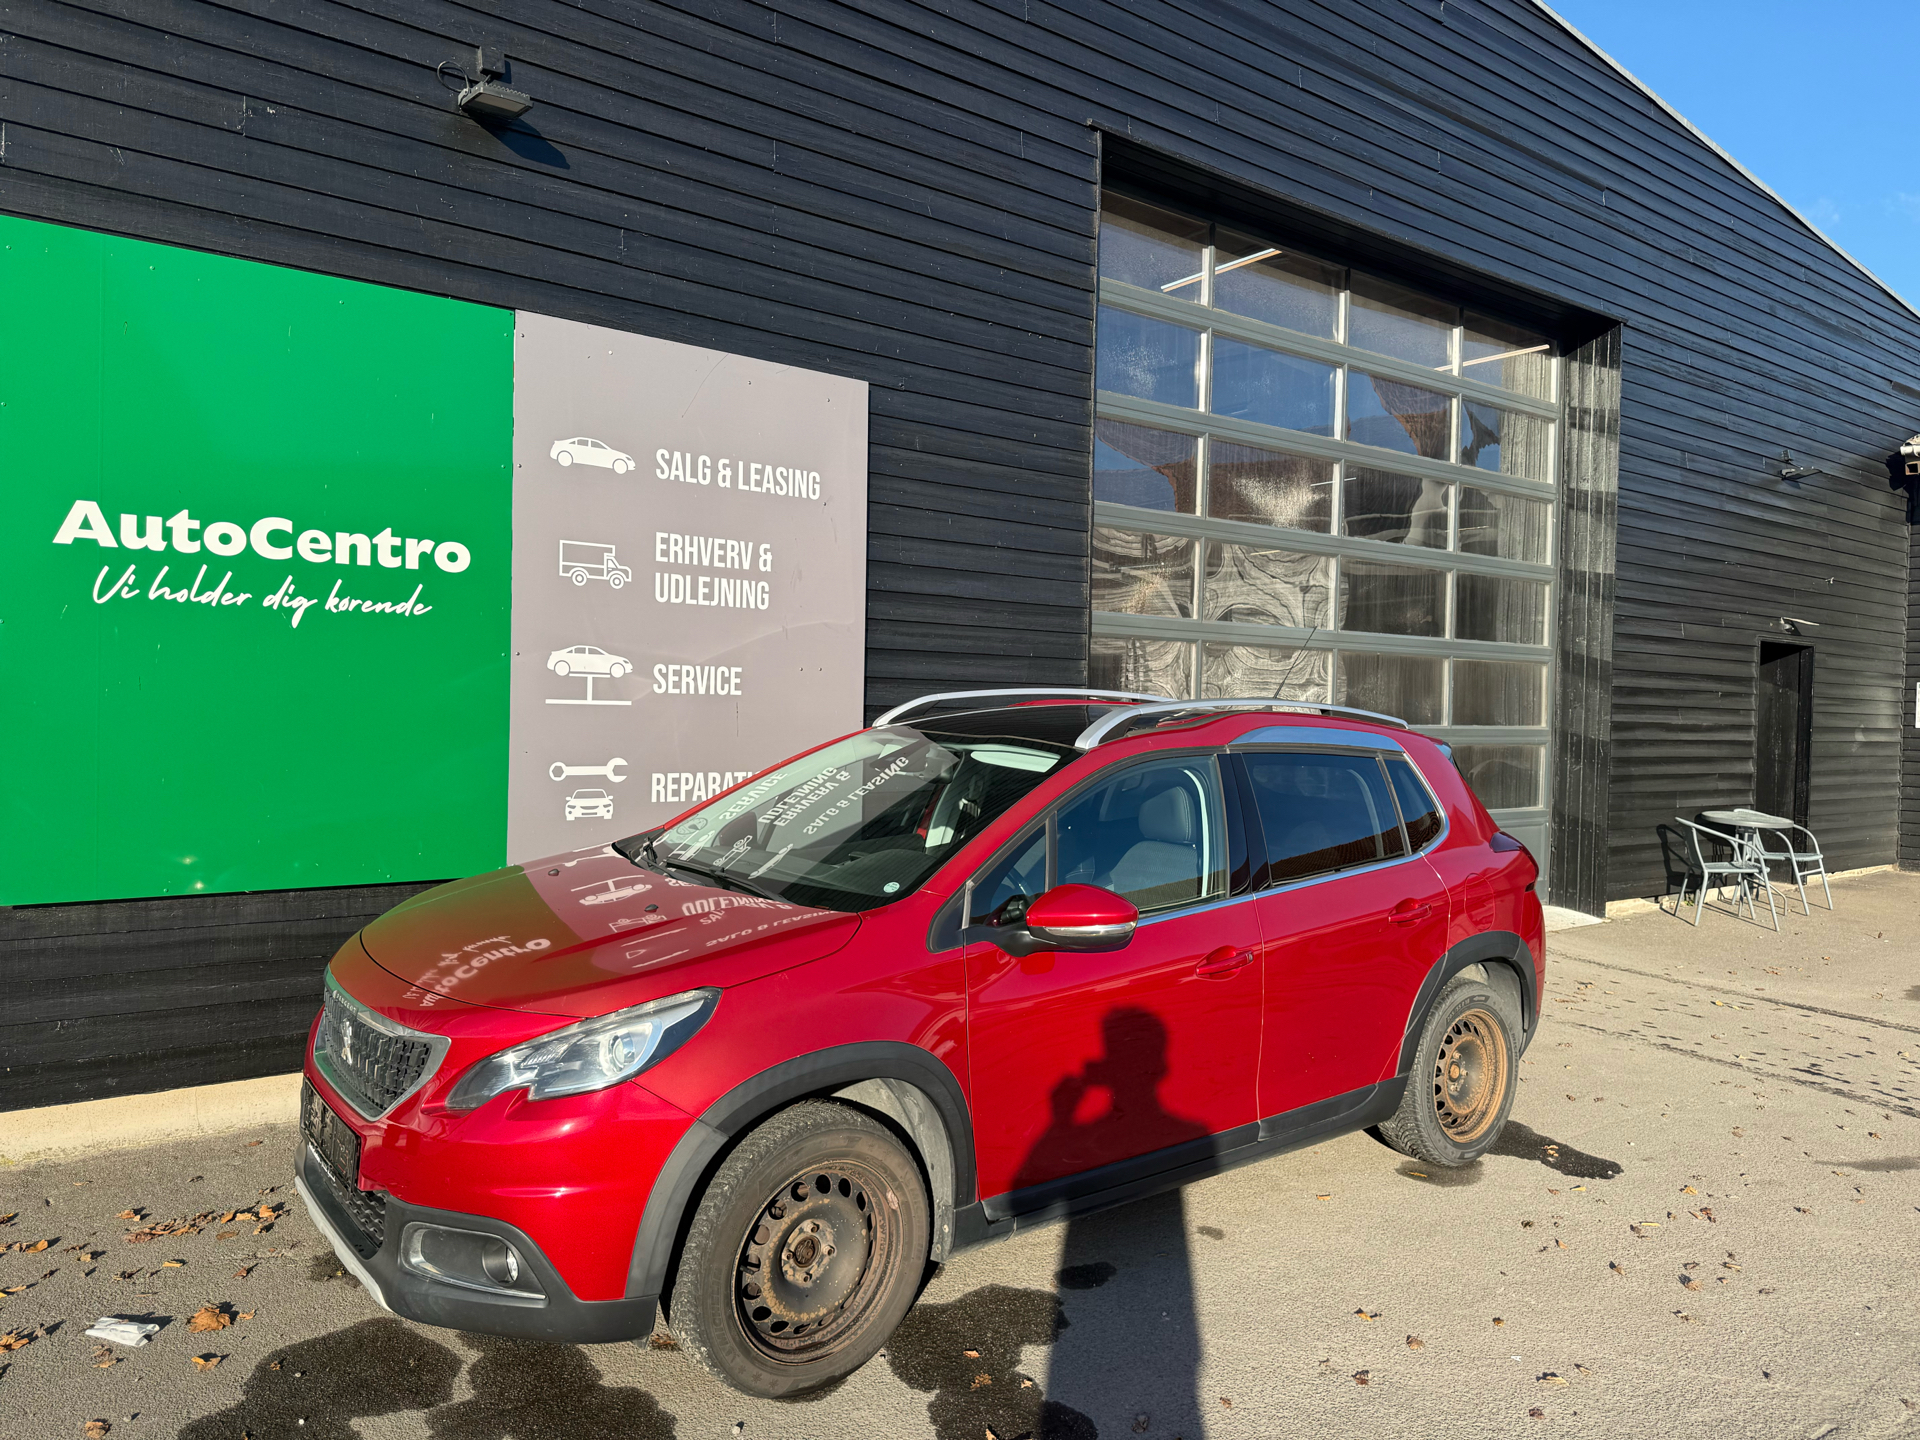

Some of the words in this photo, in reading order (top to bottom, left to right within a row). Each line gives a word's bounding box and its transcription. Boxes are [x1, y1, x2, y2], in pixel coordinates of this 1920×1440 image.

[655, 448, 711, 486] SALG
[717, 458, 732, 489] &
[738, 460, 821, 500] LEASING
[52, 499, 471, 573] AutoCentro
[655, 532, 753, 571] ERHVERV
[759, 543, 773, 572] &
[92, 563, 140, 604] Vi
[148, 564, 253, 607] holder
[262, 575, 318, 628] dig
[655, 572, 770, 611] UDLEJNING
[652, 663, 742, 696] SERVICE
[651, 770, 760, 803] REPARA
[1425, 1069, 1435, 1124] MICHELIN
